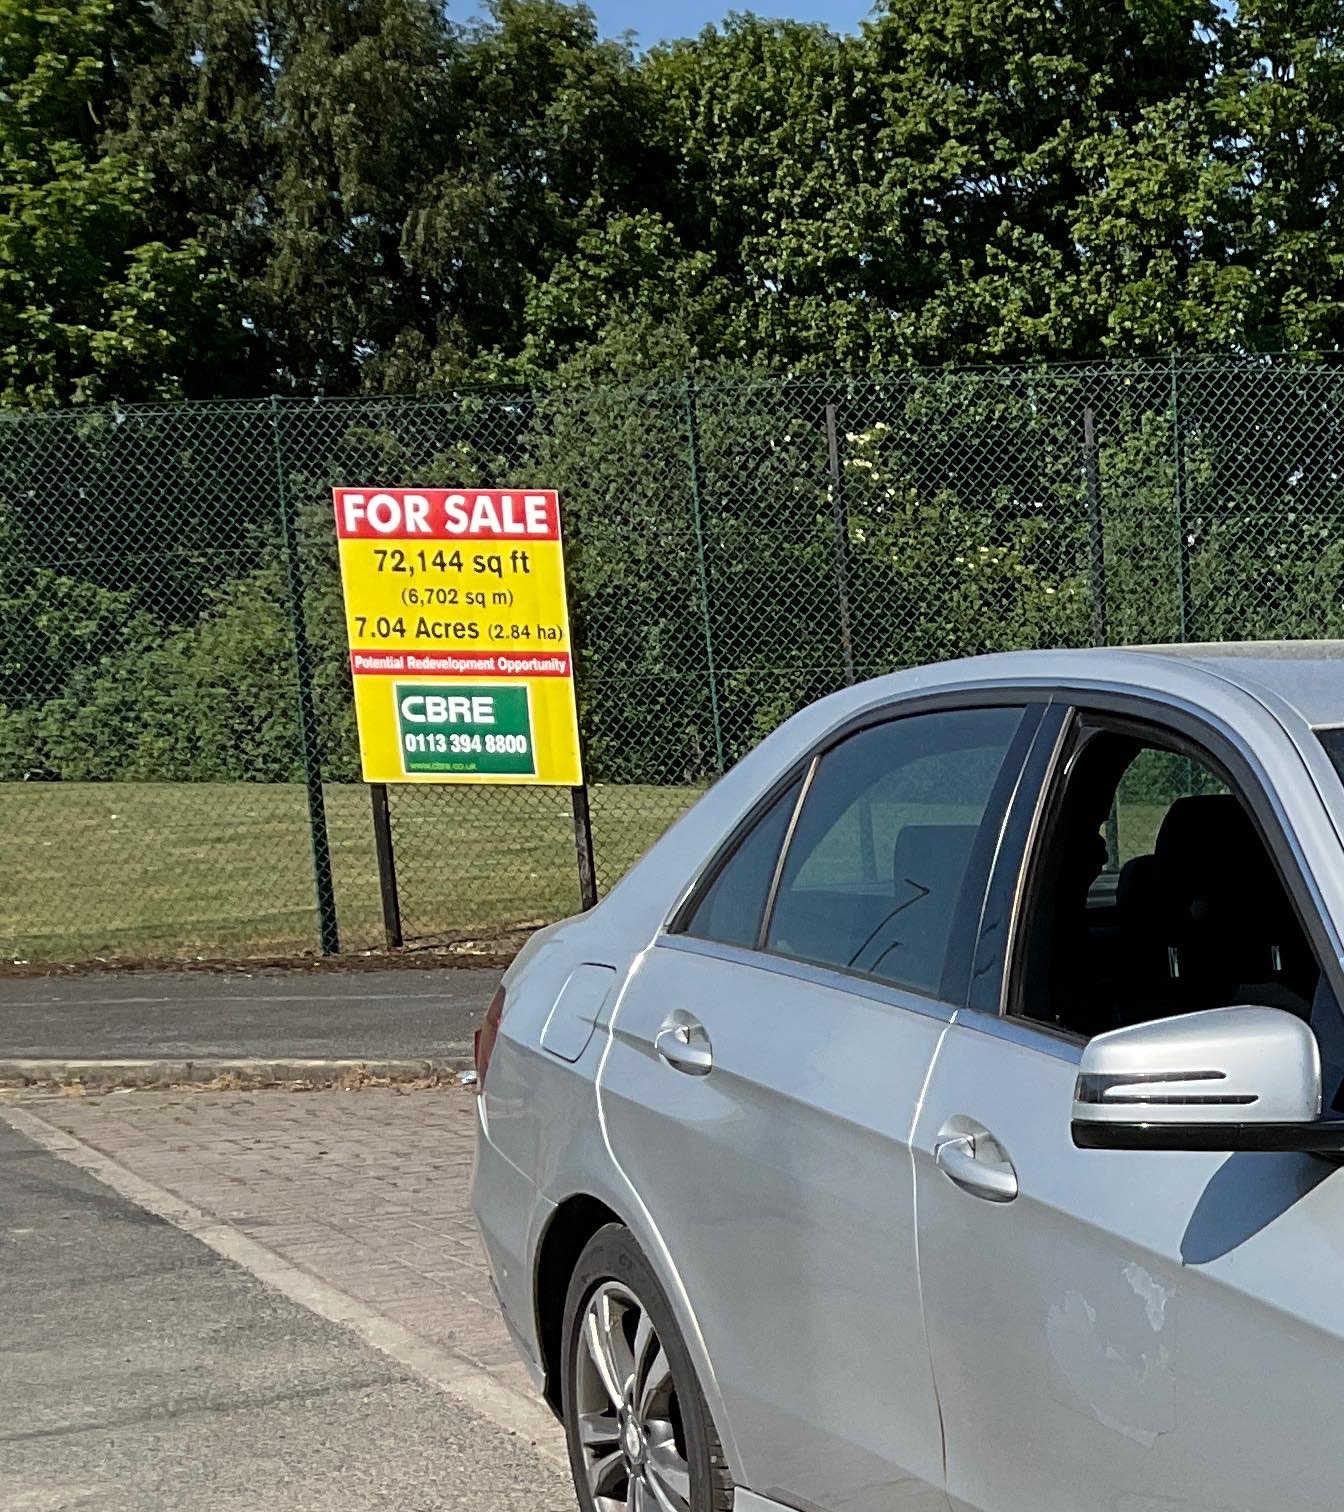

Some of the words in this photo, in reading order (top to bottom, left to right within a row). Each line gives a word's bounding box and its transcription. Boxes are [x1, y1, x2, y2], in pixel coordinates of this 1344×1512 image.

[343, 494, 432, 533] FOR
[445, 494, 549, 534] SALE
[373, 549, 464, 577] 72,144
[473, 553, 503, 578] sq
[510, 550, 530, 574] ft
[401, 588, 459, 607] (6,702
[466, 591, 487, 608] sq
[492, 589, 514, 607] m)
[354, 616, 406, 638] 7.04
[415, 616, 480, 639] Acres
[488, 623, 530, 642] (2.84
[537, 624, 563, 642] ha)
[355, 655, 404, 669] Potential
[407, 656, 495, 672] Redevelopment
[498, 657, 566, 673] Opportunity
[401, 695, 496, 723] CBRE
[405, 733, 447, 752] 0113
[450, 733, 482, 753] 394
[484, 734, 528, 753] 8800
